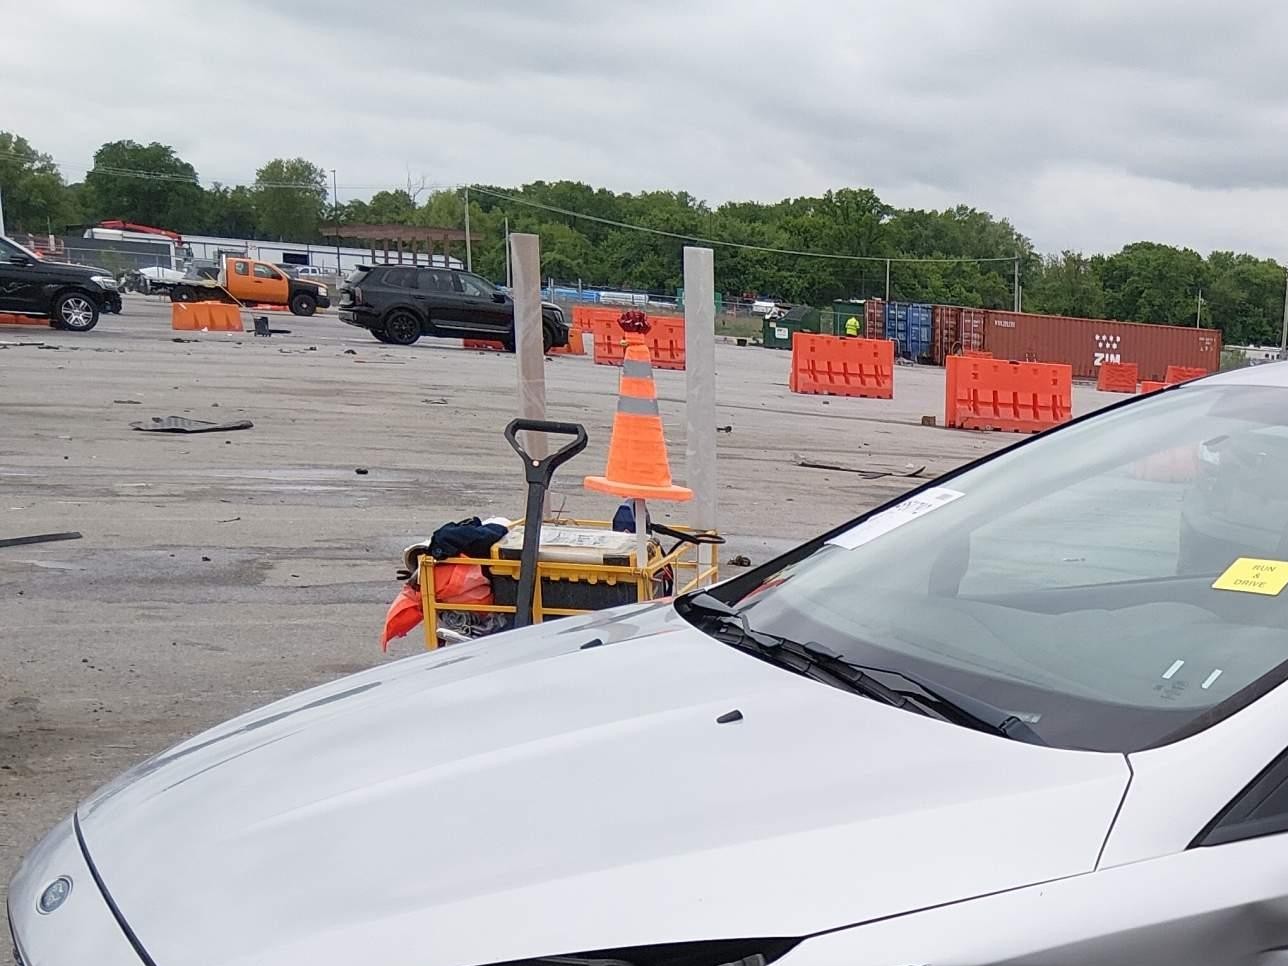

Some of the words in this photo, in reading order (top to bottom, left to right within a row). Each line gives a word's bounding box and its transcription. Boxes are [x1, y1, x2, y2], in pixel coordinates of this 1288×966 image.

[1093, 352, 1120, 366] ZIM
[1252, 564, 1277, 572] RUN
[1233, 579, 1267, 588] DRIVE
